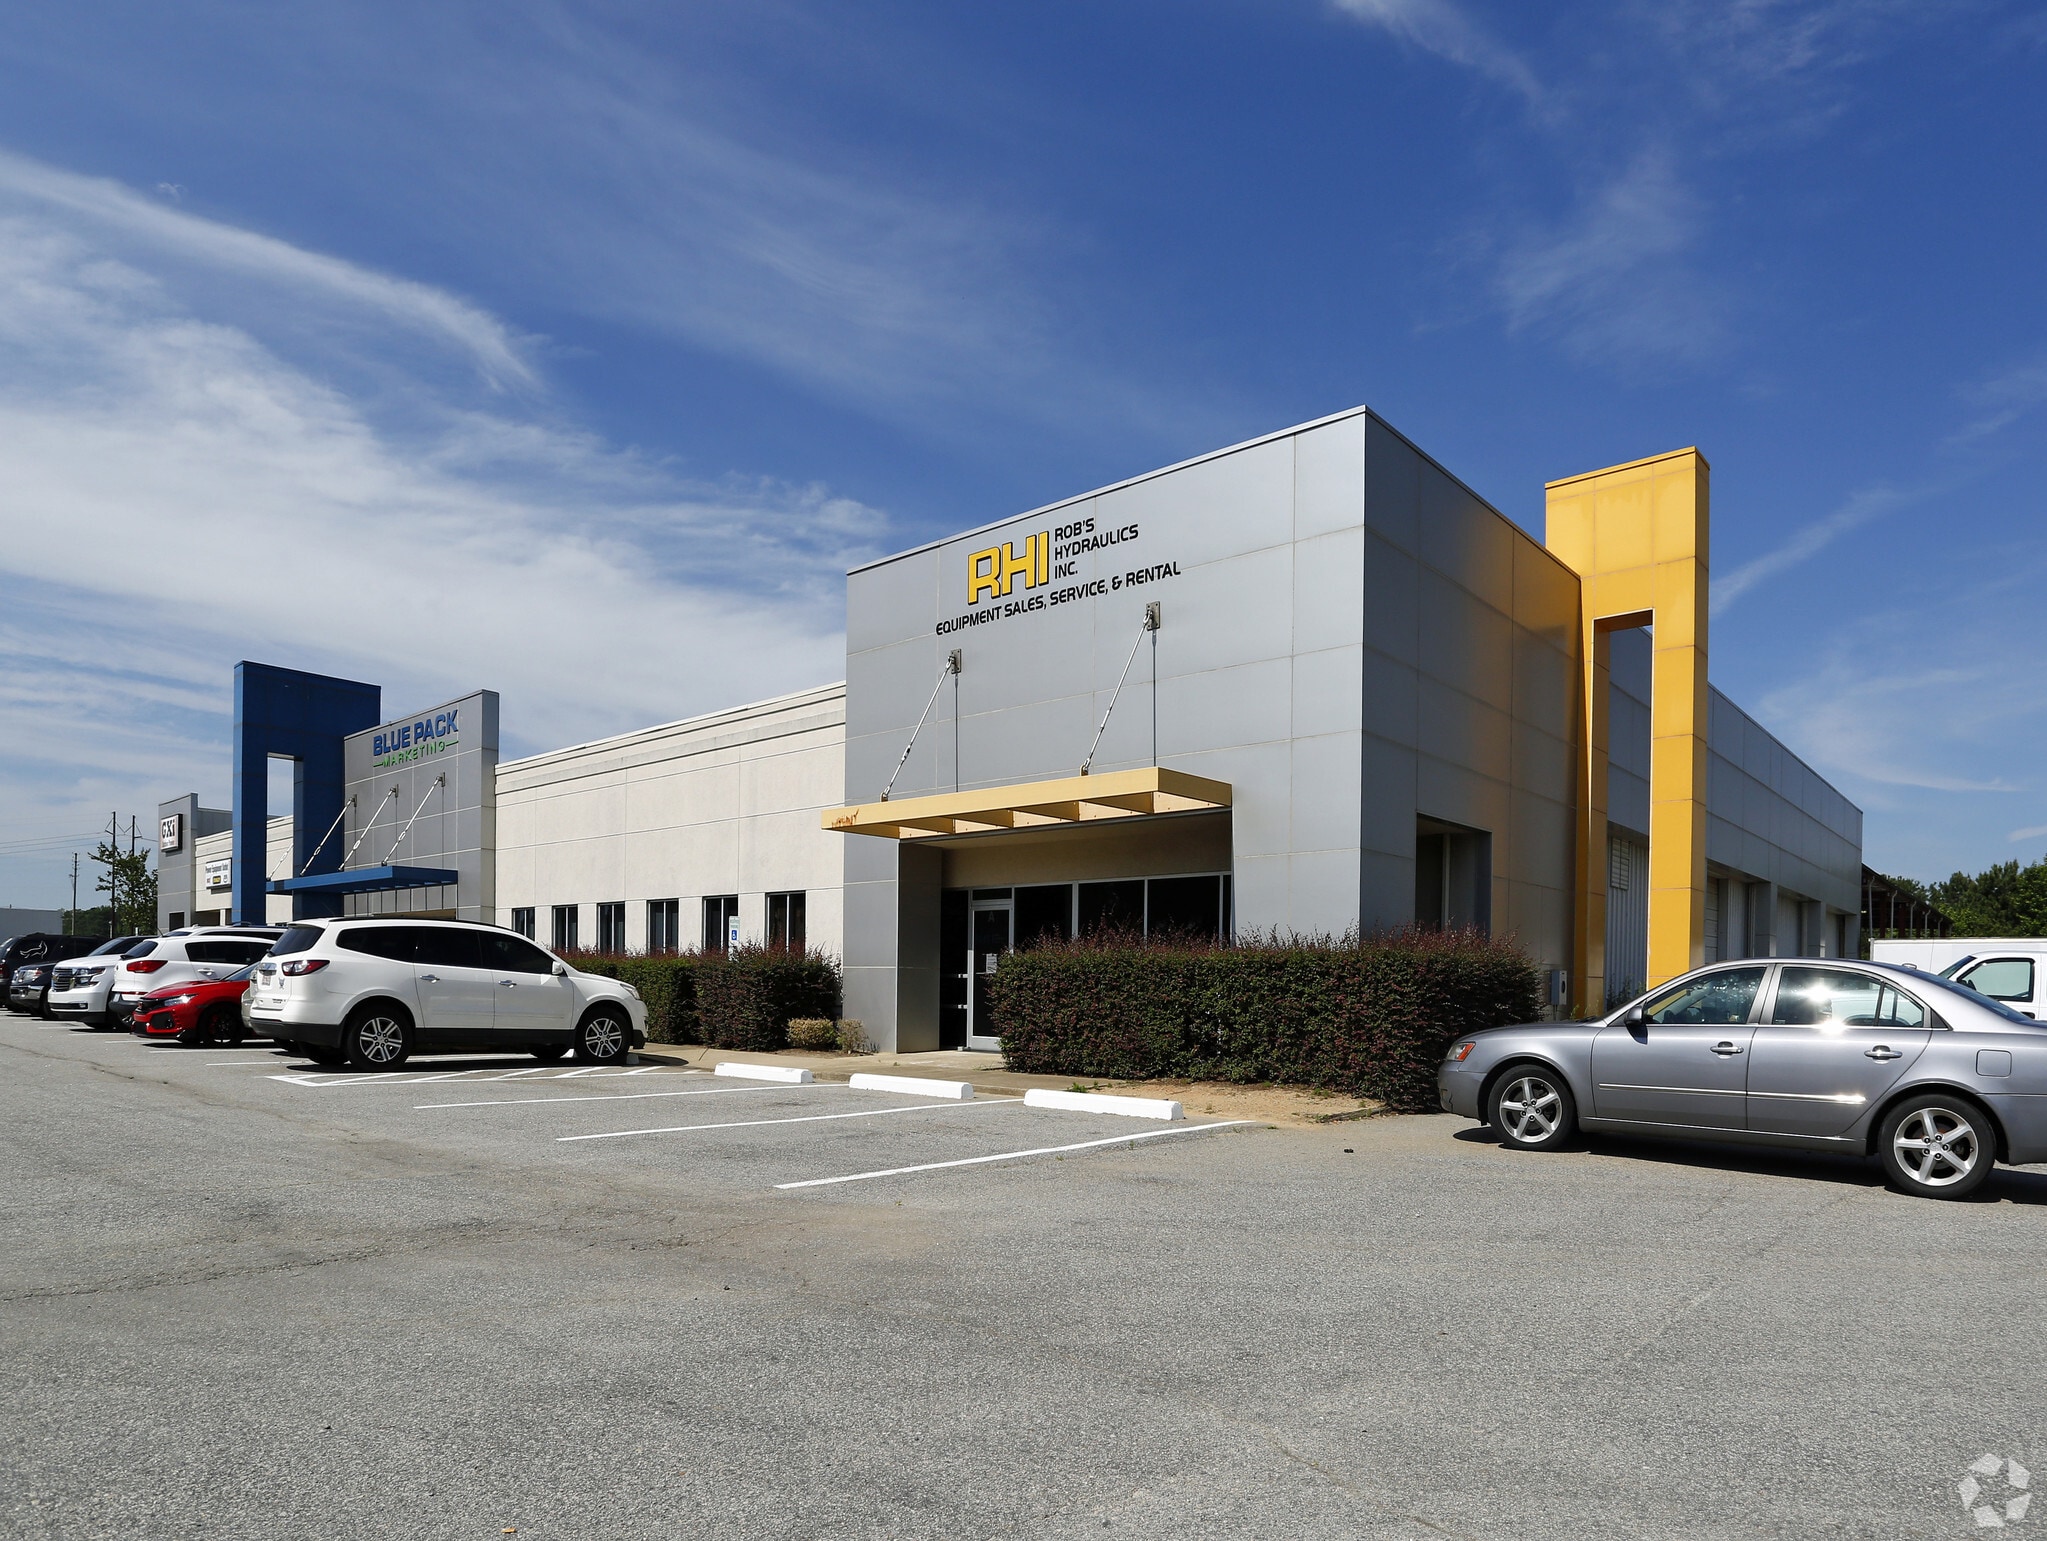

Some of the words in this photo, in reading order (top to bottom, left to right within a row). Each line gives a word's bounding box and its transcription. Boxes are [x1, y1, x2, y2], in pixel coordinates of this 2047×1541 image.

[1054, 517, 1095, 542] ROB'S
[1054, 523, 1139, 561] HYDRAULICS
[967, 531, 1050, 606] RHI
[1054, 561, 1078, 580] INC.
[935, 605, 1002, 636] EQUIPMENT
[1004, 595, 1047, 618] SALES,
[1049, 579, 1109, 606] SERVICE,
[1111, 575, 1122, 590] &
[1125, 561, 1181, 588] RENTAL
[373, 725, 411, 757] BLUE
[414, 709, 459, 745] PACK
[383, 741, 446, 768] MARKETING
